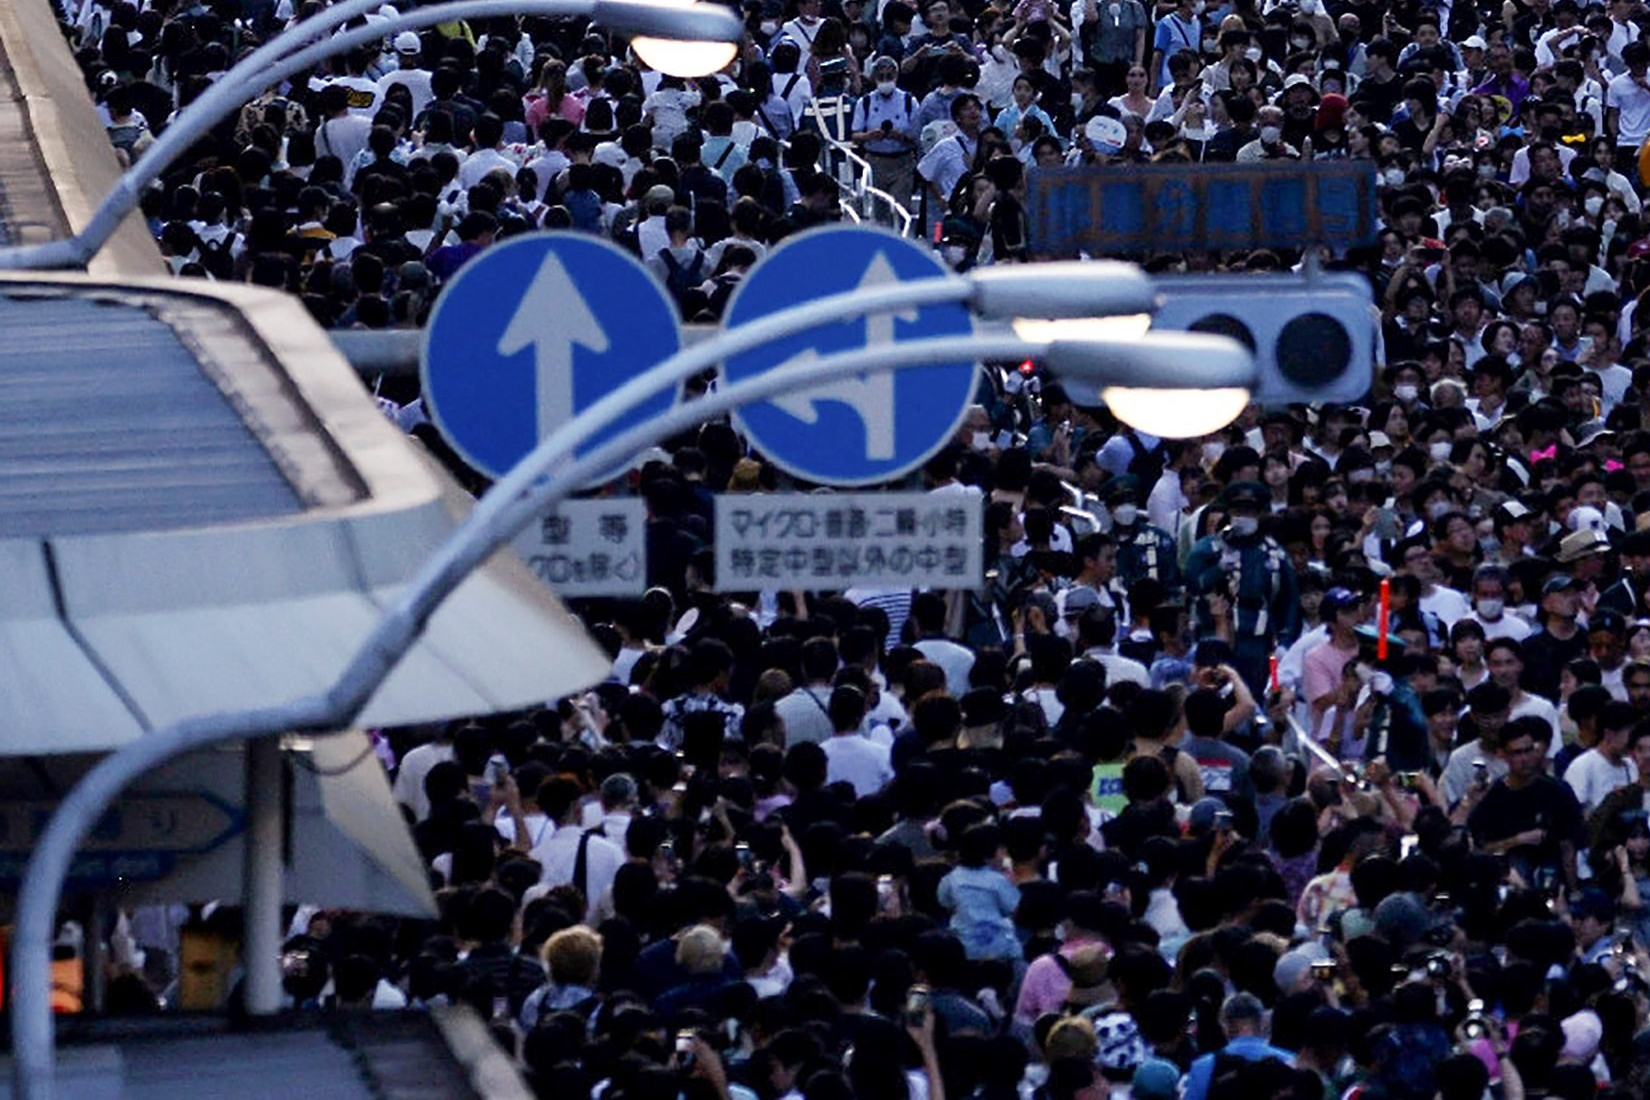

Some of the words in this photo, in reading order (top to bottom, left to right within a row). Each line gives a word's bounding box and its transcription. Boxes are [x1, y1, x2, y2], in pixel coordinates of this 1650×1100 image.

[729, 544, 969, 580] 特定中型以外の中型
